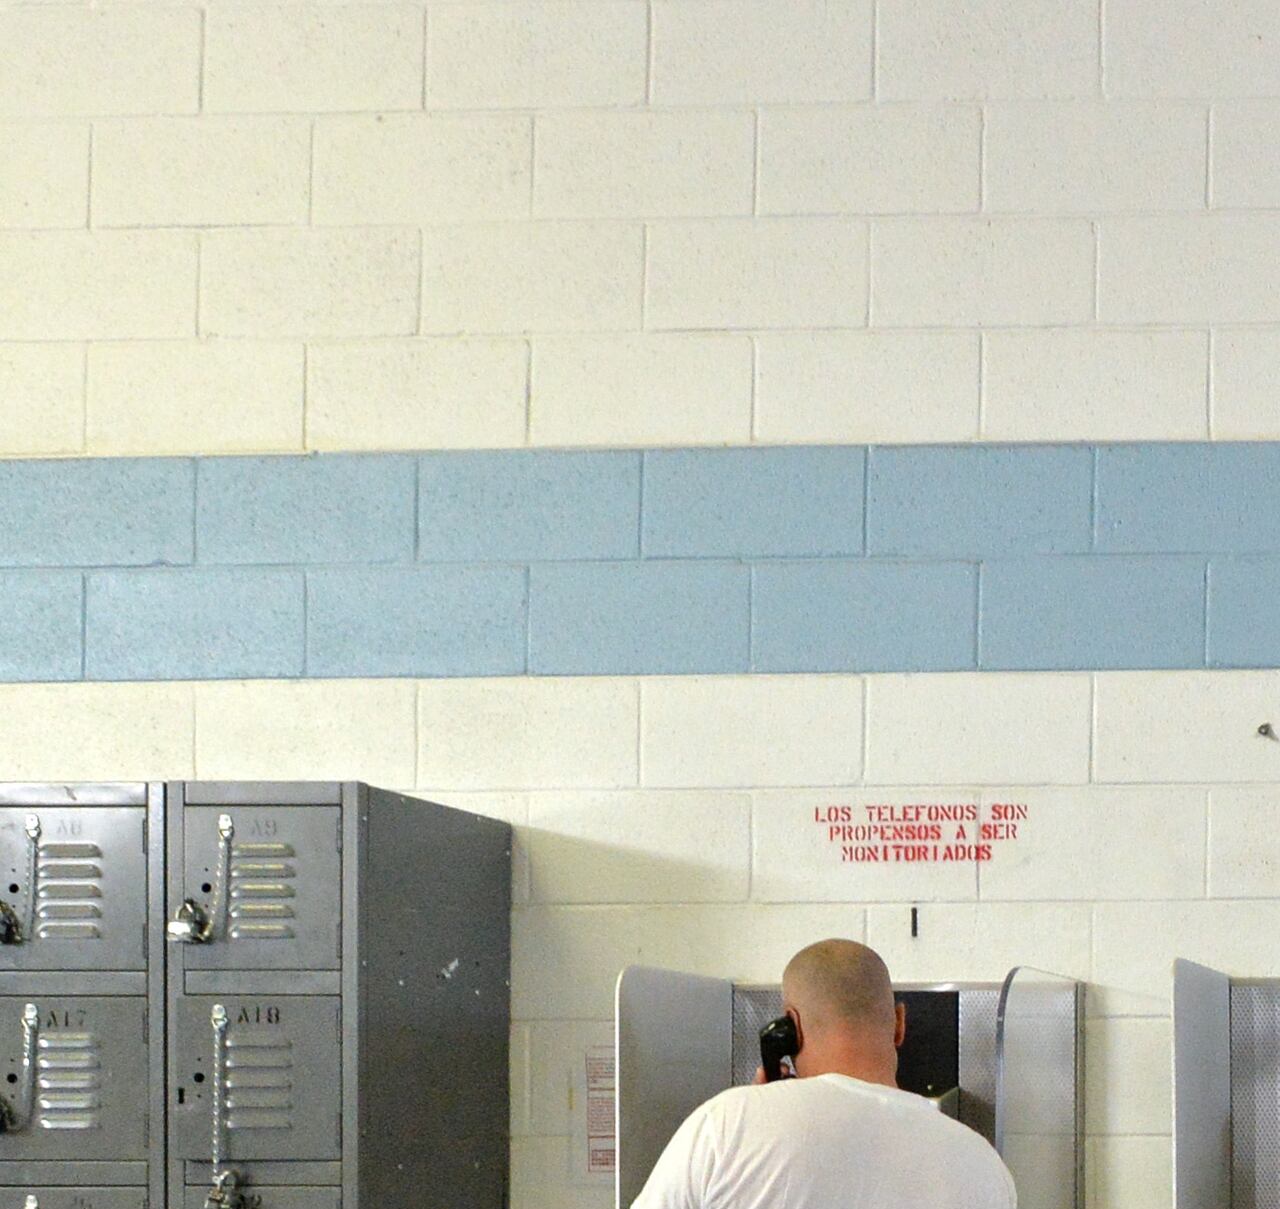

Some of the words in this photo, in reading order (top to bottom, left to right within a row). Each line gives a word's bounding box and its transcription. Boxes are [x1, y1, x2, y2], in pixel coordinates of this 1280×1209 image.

[815, 806, 852, 822] LOS
[866, 805, 977, 822] TELEFONOS
[991, 804, 1028, 821] SON
[828, 824, 942, 842] PROPENSOS
[955, 825, 967, 841] A
[980, 824, 1017, 841] SER
[841, 844, 993, 863] MONITORIADOS
[47, 1009, 87, 1028] A17
[237, 1005, 281, 1025] A18
